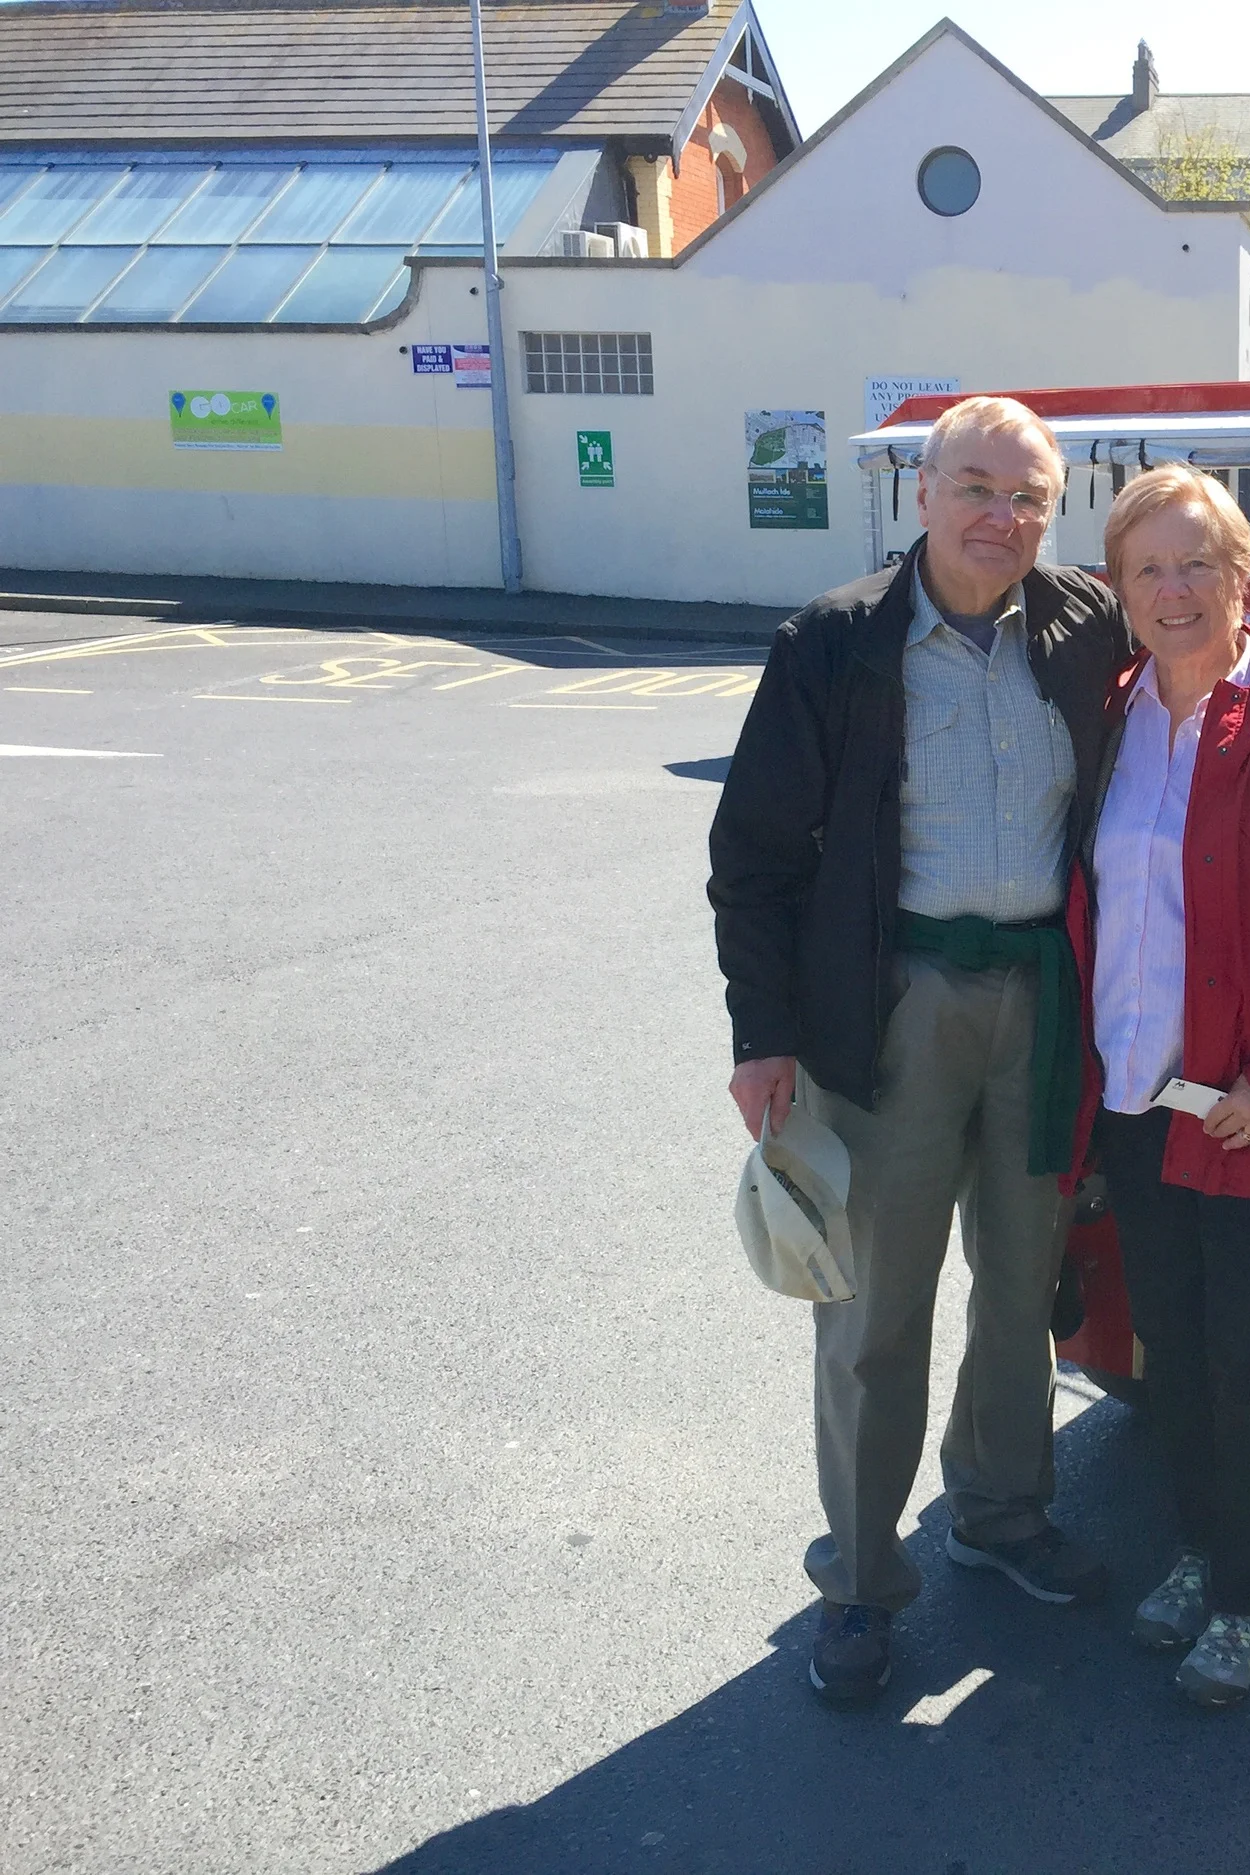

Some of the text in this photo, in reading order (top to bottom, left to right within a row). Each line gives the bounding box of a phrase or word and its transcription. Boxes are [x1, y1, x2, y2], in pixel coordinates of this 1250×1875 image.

[434, 346, 447, 354] YOU
[416, 364, 450, 372] DISPLAYED
[872, 381, 953, 392] DO NOT LEAVE
[870, 392, 894, 401] ANY
[754, 507, 784, 515] Malahide
